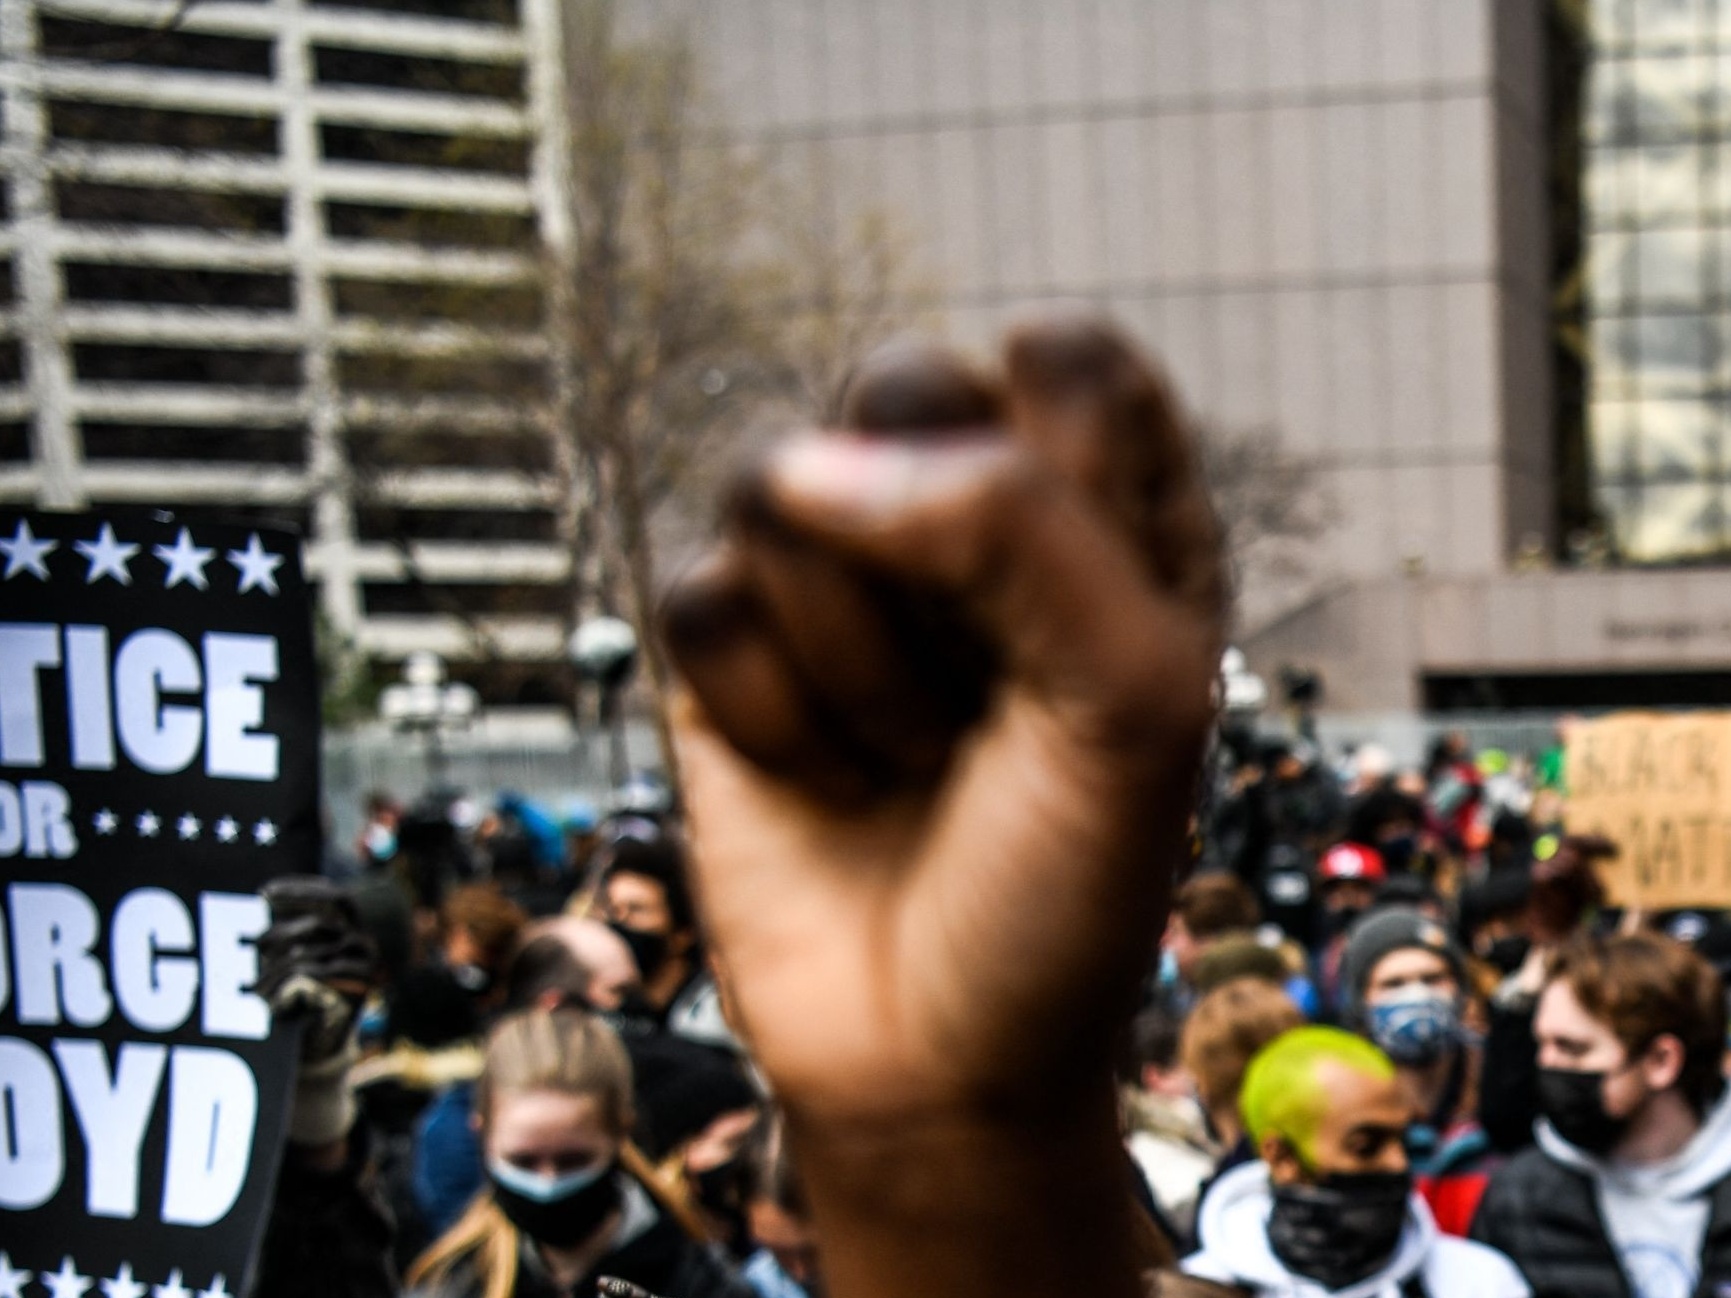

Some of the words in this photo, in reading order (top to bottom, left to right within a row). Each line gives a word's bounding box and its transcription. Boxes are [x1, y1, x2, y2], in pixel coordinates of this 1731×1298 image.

[0, 622, 280, 781] TICE
[0, 882, 272, 1040] RGE
[0, 1035, 259, 1228] OYD
